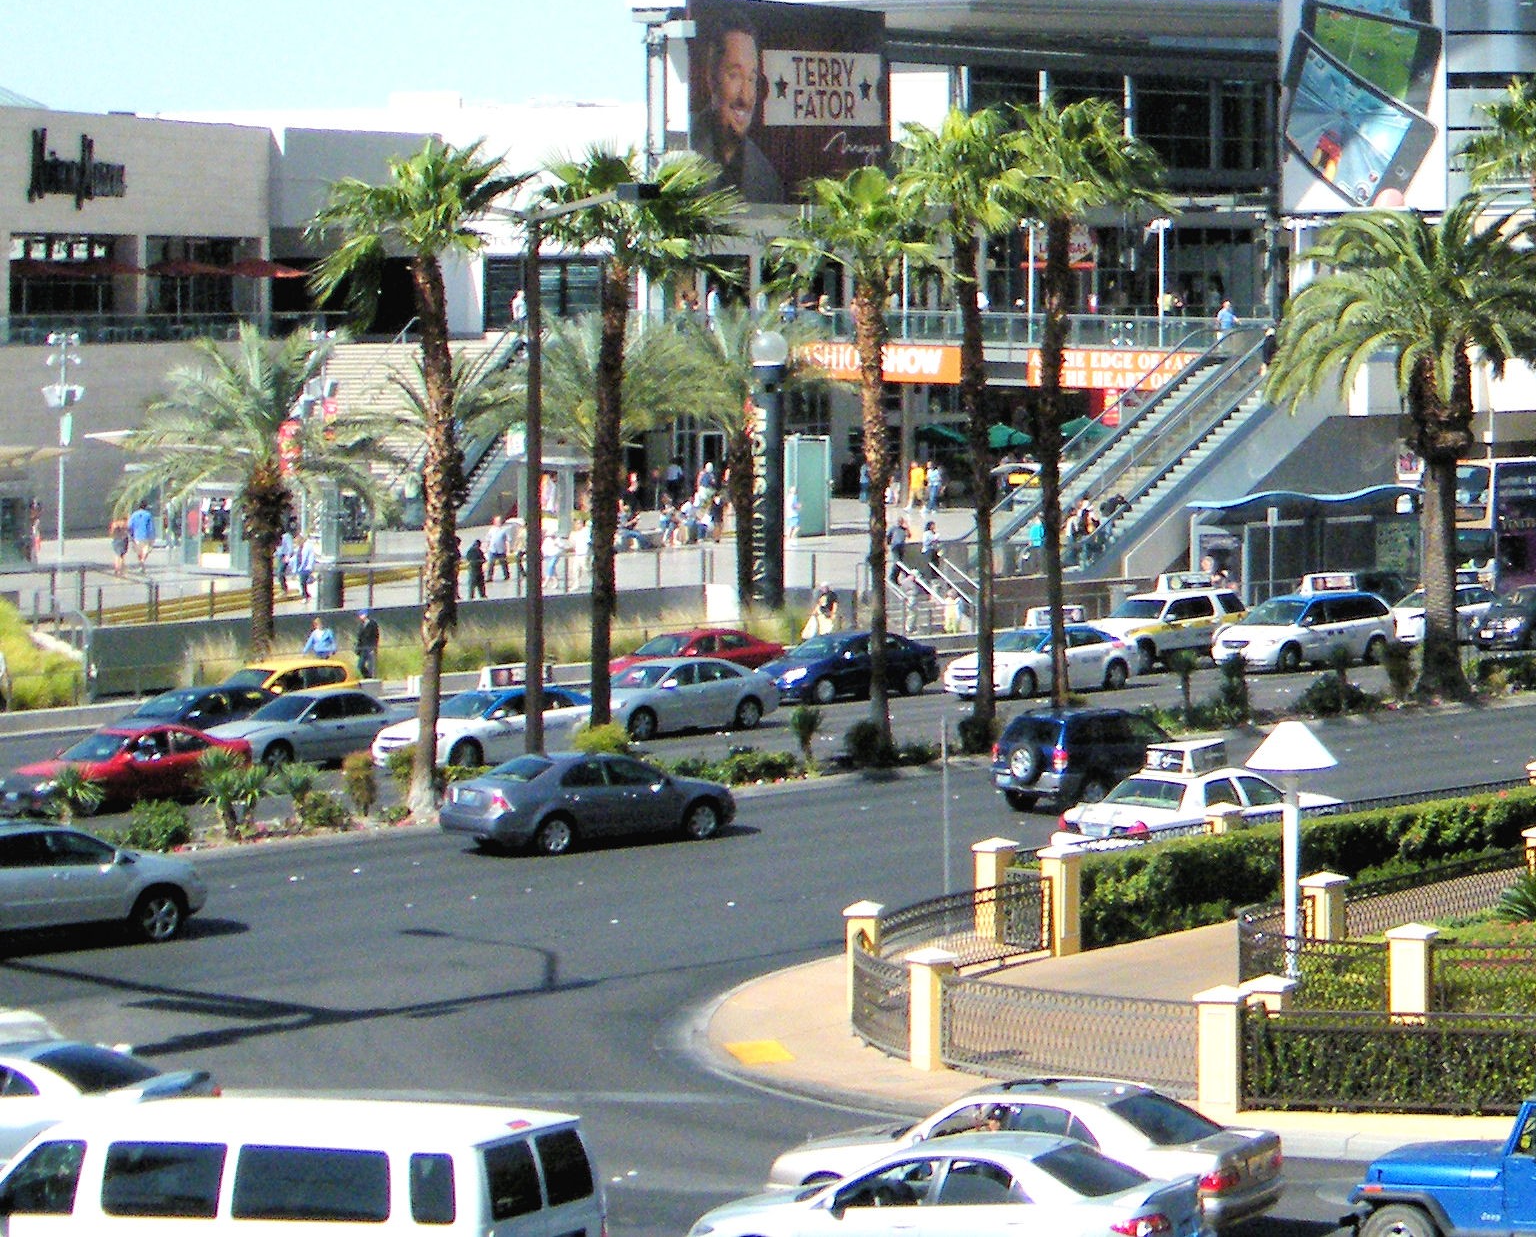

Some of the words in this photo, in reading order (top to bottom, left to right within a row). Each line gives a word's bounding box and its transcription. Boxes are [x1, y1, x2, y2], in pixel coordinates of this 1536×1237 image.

[792, 56, 856, 88] TERRY
[793, 89, 856, 121] FATOR
[1090, 351, 1134, 370] EDGE
[1137, 353, 1160, 370] OF
[1092, 371, 1145, 389] HEART
